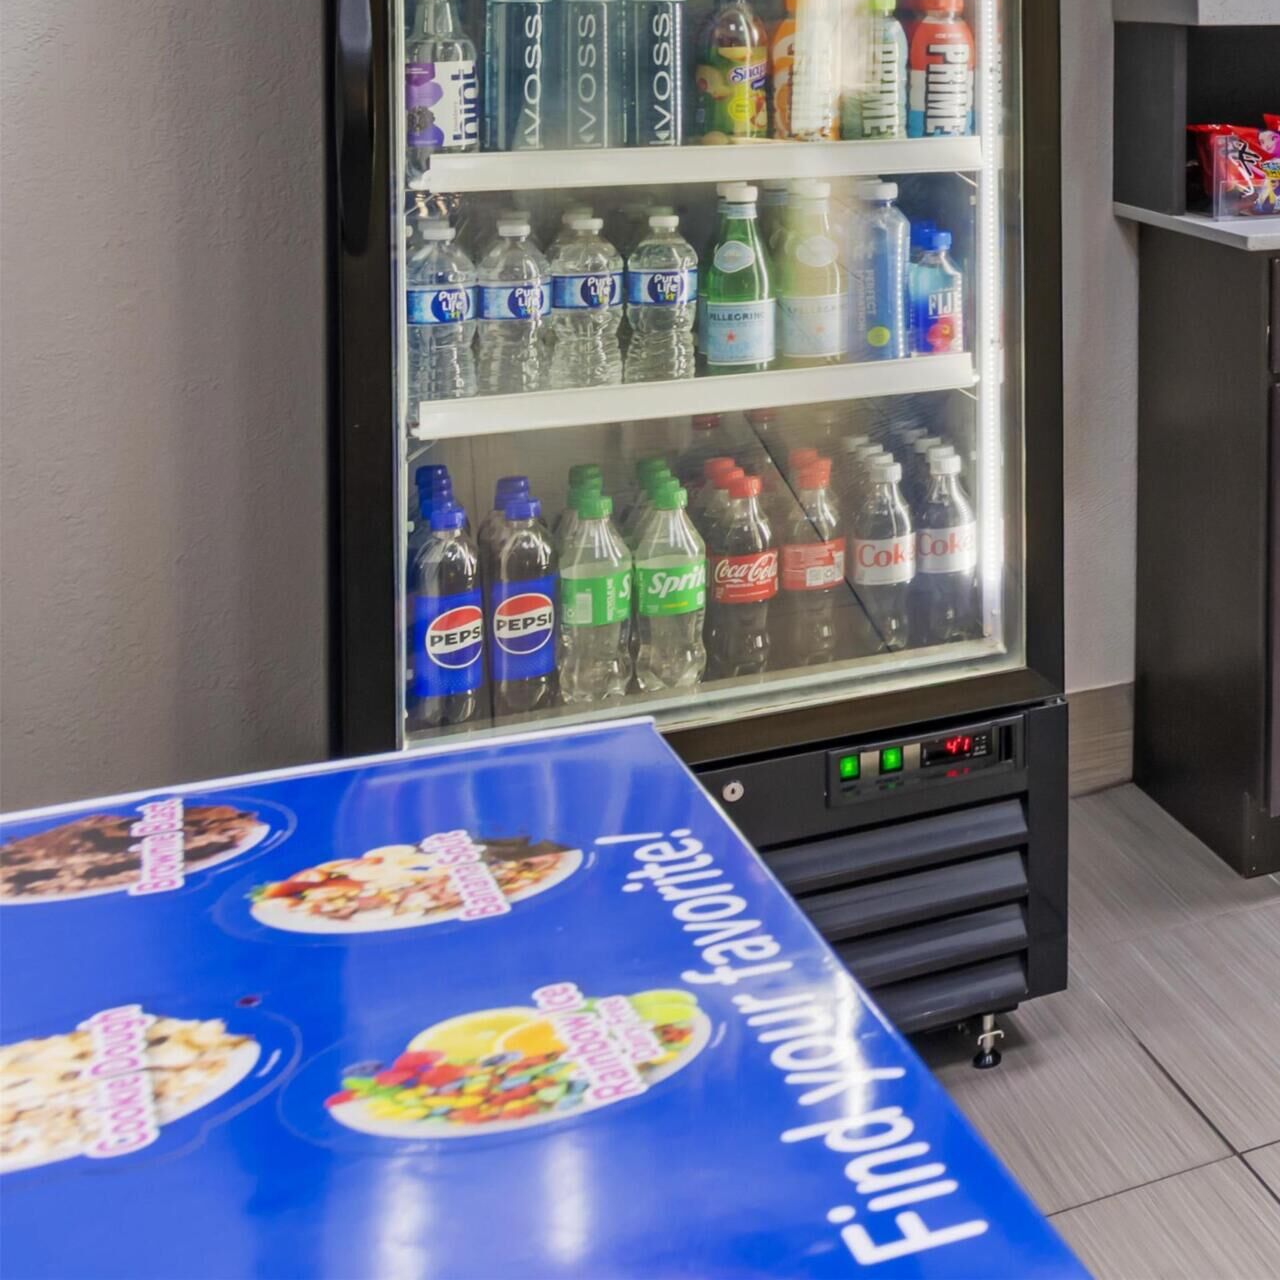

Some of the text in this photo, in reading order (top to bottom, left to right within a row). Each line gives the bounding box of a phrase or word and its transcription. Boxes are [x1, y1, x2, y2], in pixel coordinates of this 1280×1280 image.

[451, 66, 478, 141] hint
[524, 14, 542, 136] VOSS
[578, 13, 597, 134] VOSS
[652, 11, 673, 131] VOSS
[496, 611, 553, 632] PEPSI
[648, 567, 706, 598] Sprit
[453, 865, 504, 918] Banana
[90, 1013, 149, 1153] Cookie Dough
[536, 984, 634, 1100] Rainbow Ice
[594, 828, 989, 1266] Find your favorite!
